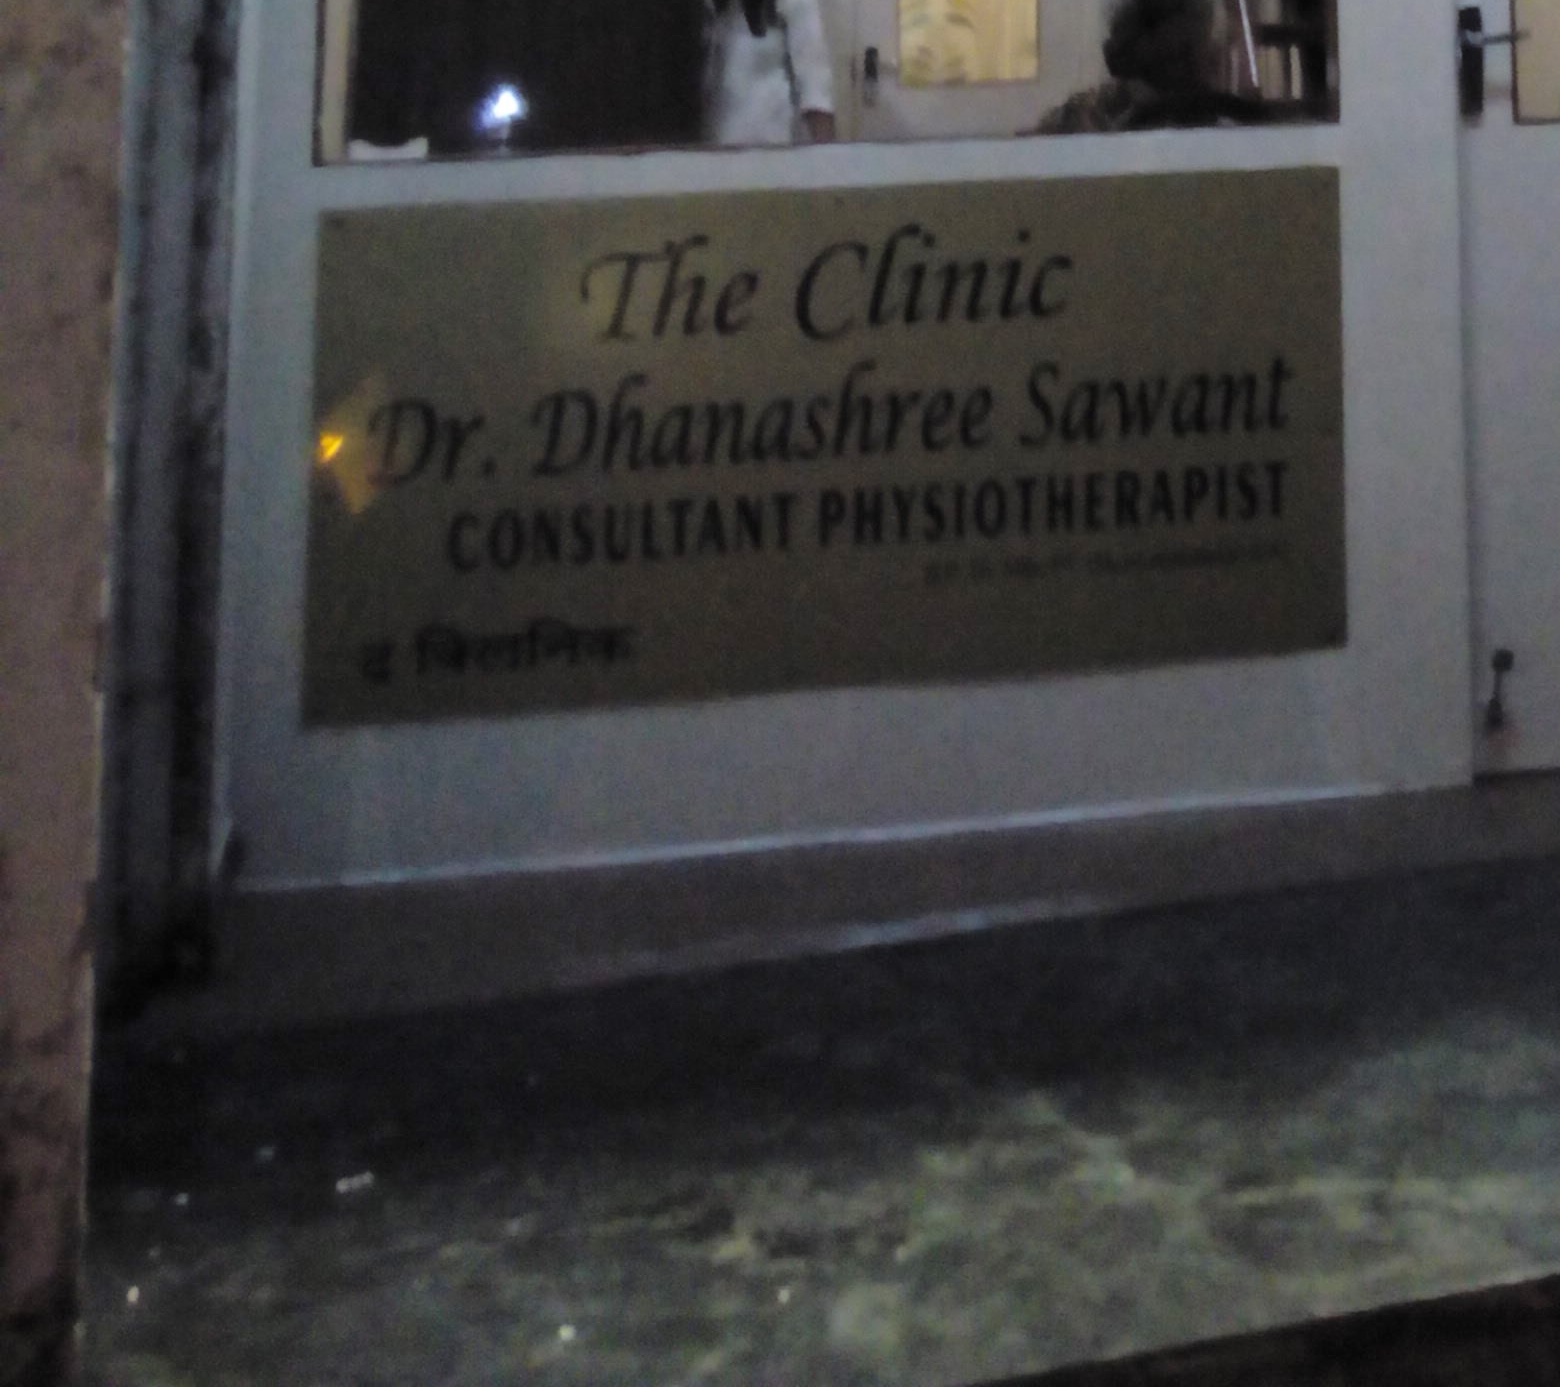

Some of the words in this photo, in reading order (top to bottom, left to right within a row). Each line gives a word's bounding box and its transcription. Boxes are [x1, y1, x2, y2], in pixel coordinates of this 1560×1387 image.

[581, 233, 760, 347] The
[793, 224, 1074, 344] Clinic
[366, 395, 497, 489] Dr.
[531, 362, 994, 484] Dhanashree
[1019, 355, 1297, 451] Sawant
[445, 490, 798, 576] CONSULTANT
[818, 460, 1290, 552] PHYSIOTHERAPIST
